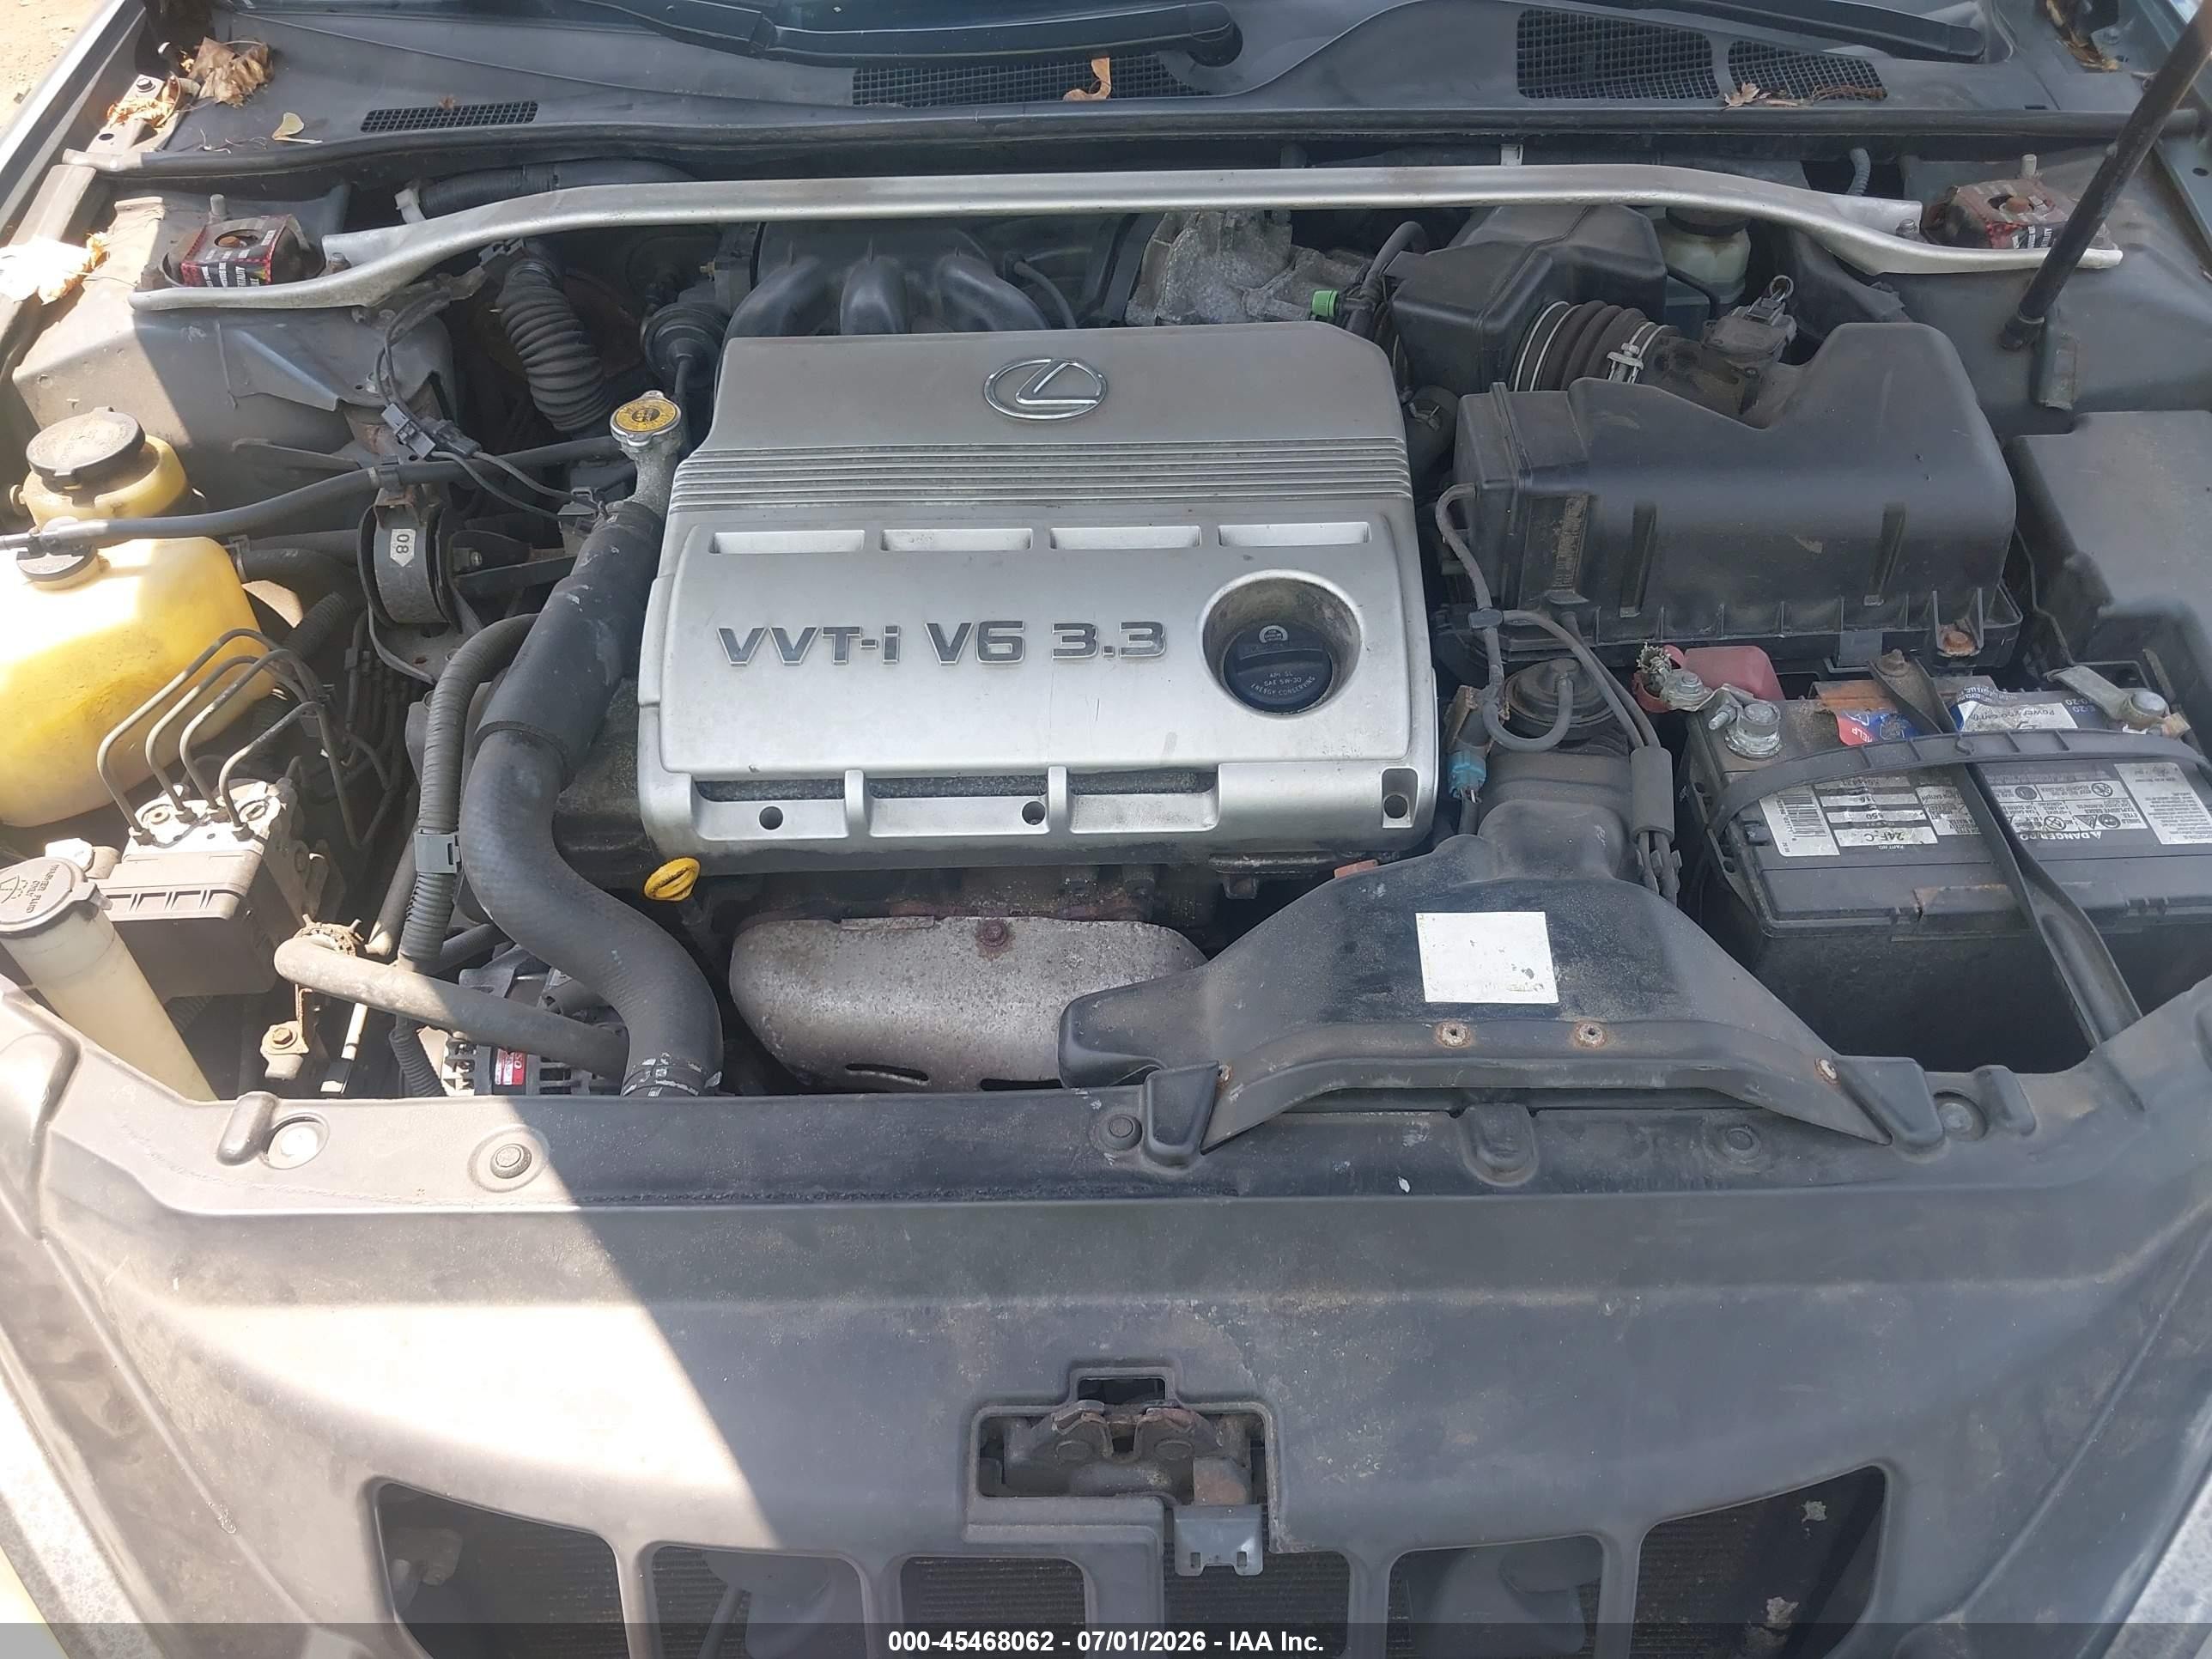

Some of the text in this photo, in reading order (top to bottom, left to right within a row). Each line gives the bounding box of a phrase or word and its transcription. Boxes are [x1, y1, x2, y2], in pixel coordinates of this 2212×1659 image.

[716, 619, 1166, 667] VVT-i V6 3.3
[1863, 830, 1905, 842] 24F-C
